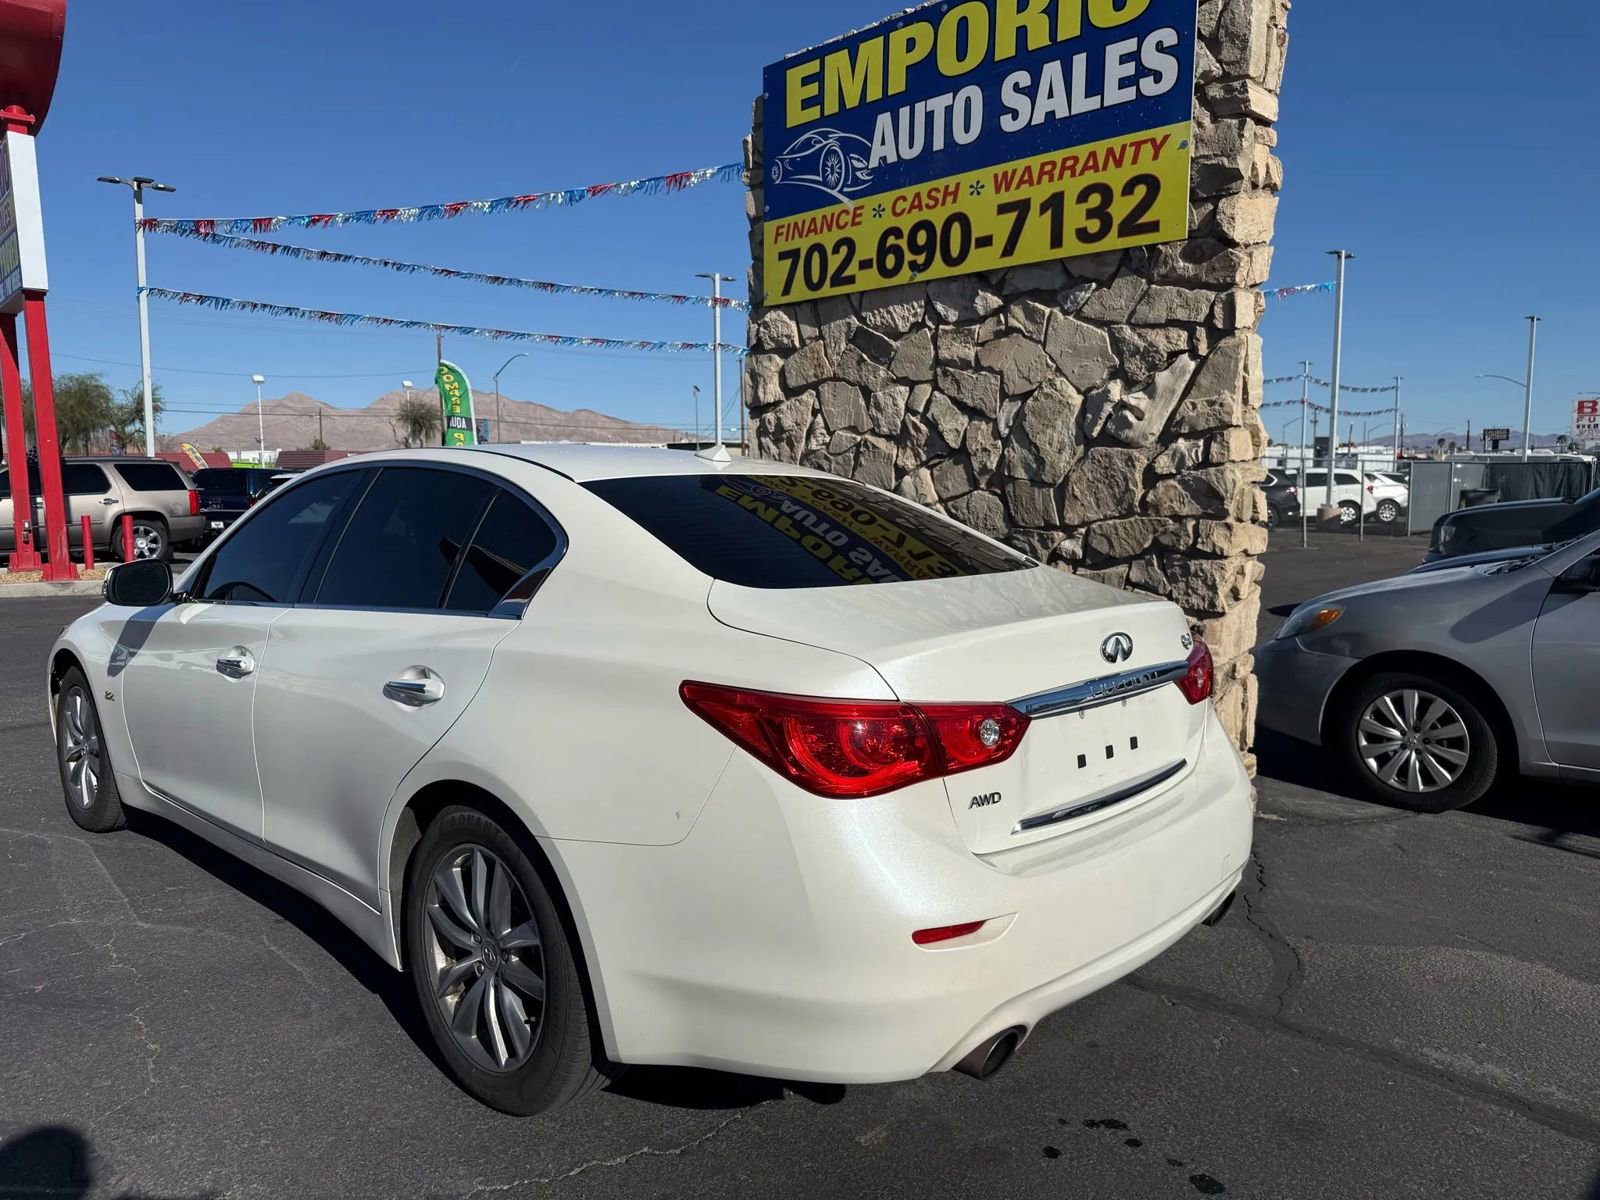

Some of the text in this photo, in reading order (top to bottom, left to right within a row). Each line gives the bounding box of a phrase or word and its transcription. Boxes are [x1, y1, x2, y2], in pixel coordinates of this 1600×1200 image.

[868, 27, 1179, 169] AUTO SALES
[774, 134, 1171, 244] FINANCE CASH WARRANTY
[778, 173, 1161, 297] 702-690-7132
[968, 791, 1002, 810] AWD
